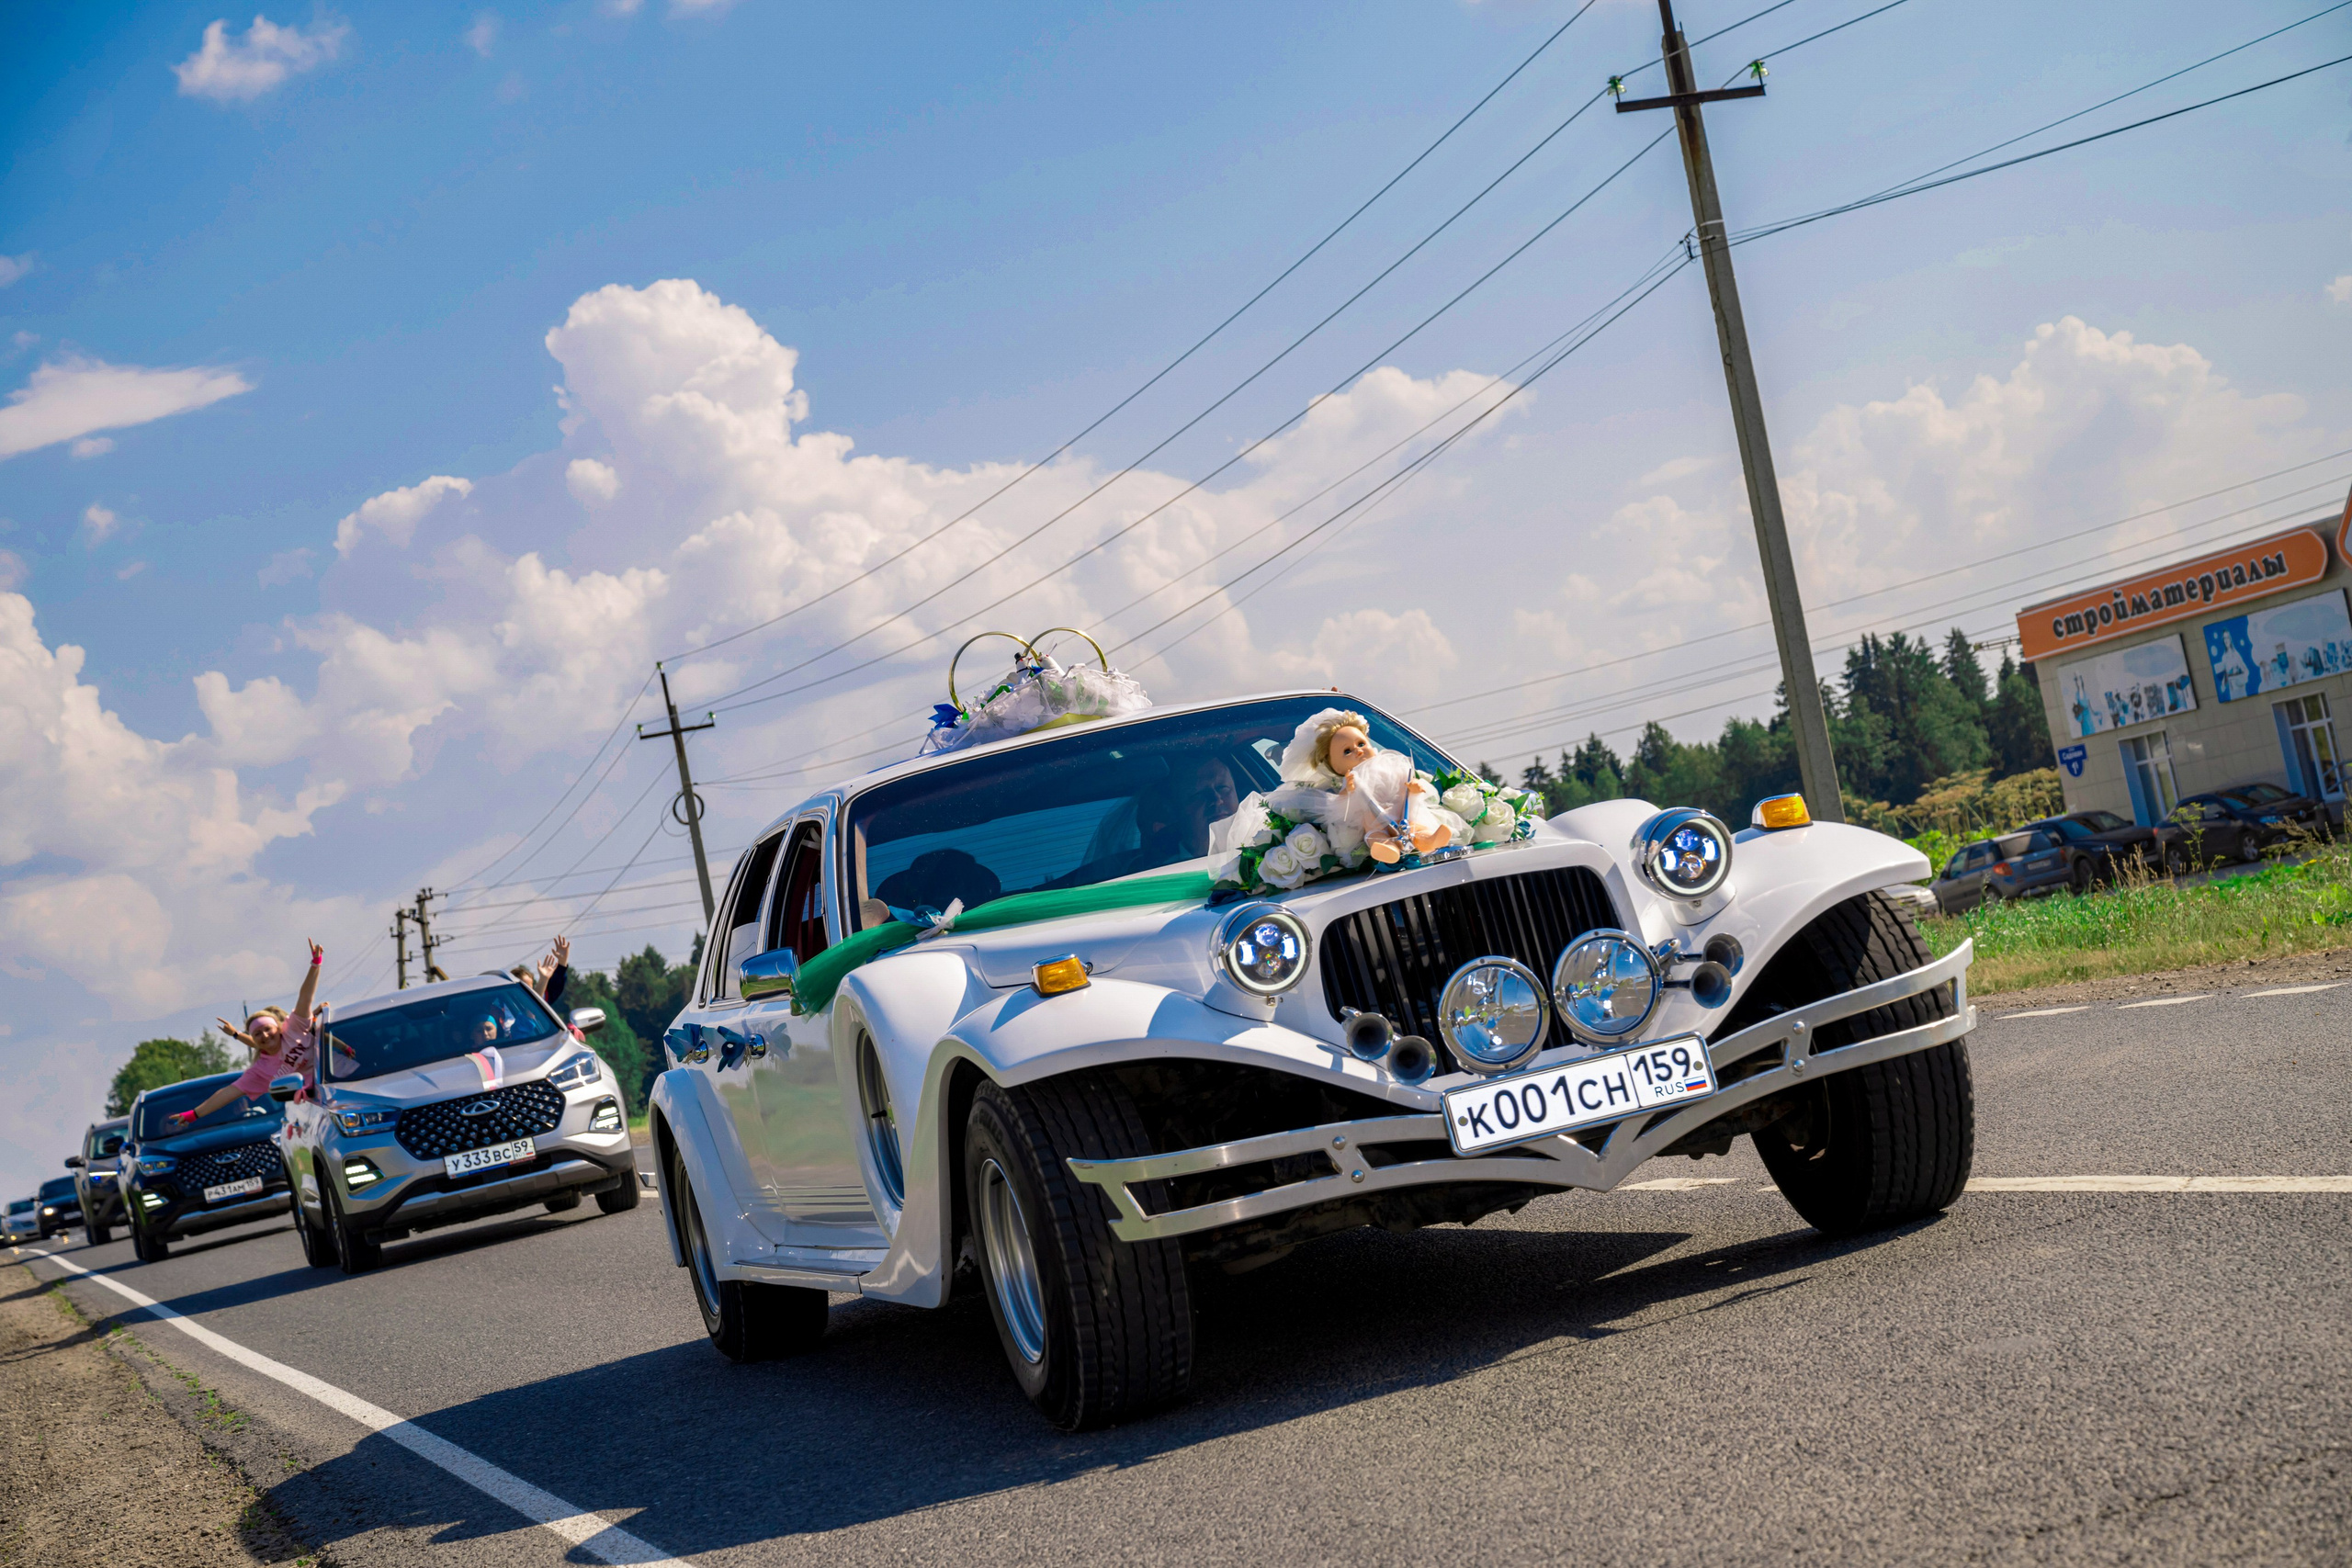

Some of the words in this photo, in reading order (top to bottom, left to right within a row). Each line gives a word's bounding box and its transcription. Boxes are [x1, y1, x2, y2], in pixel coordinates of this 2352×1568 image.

[2052, 553, 2289, 638] стройматериалы
[1633, 1047, 1691, 1086] 159
[1655, 1081, 1685, 1098] RUS
[514, 1140, 528, 1153] 59
